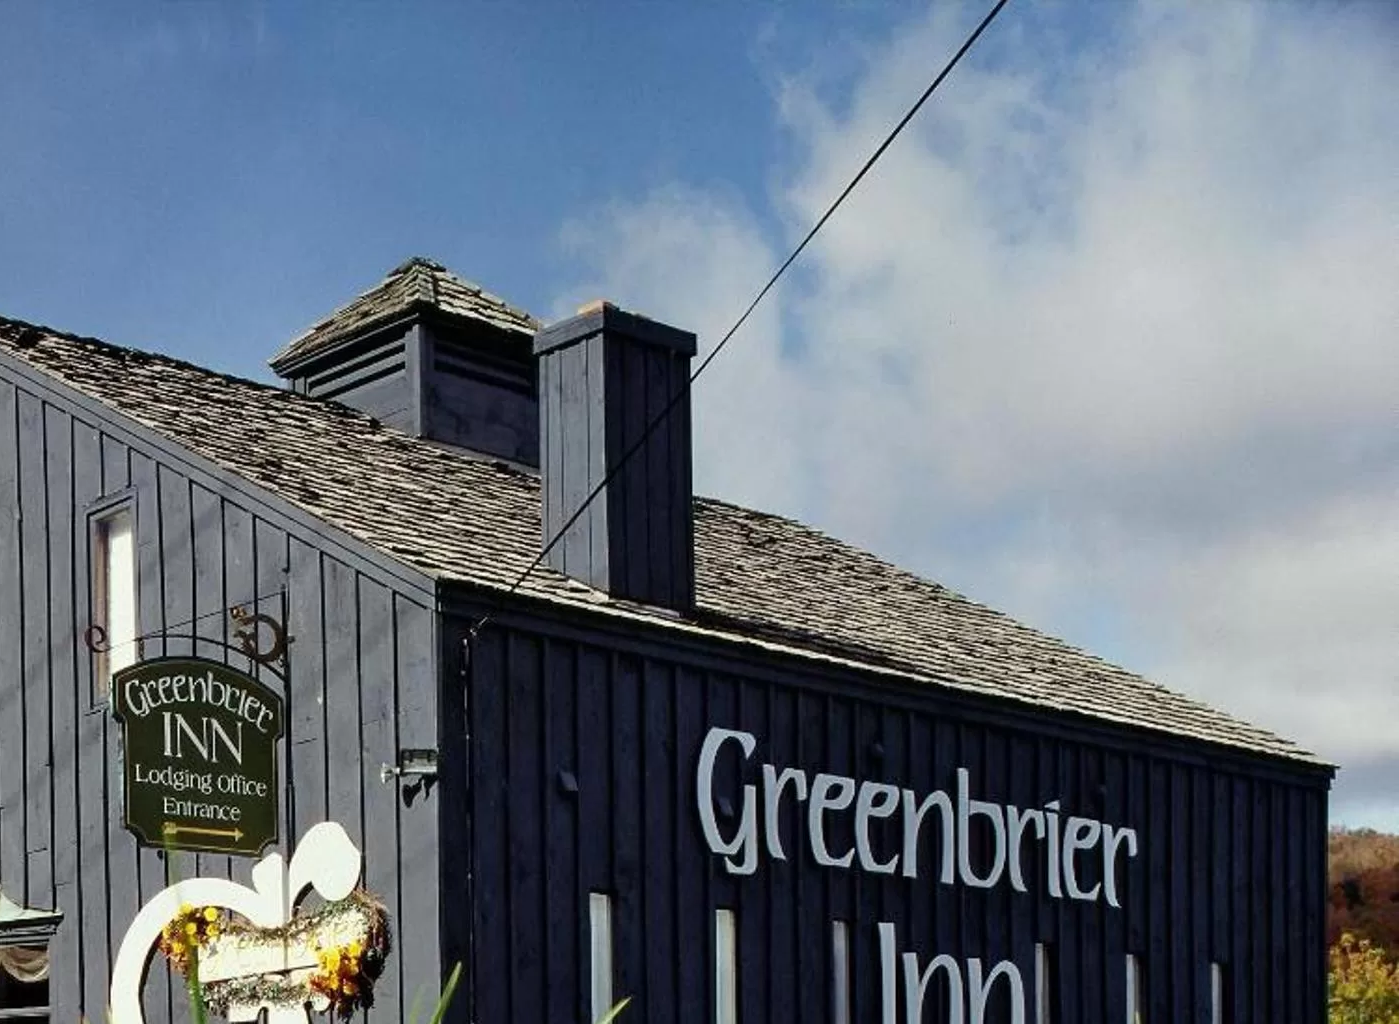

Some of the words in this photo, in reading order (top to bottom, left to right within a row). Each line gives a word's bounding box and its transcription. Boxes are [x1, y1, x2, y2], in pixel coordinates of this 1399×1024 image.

[124, 671, 274, 733] Greenbrier
[161, 711, 243, 766] INN
[135, 763, 213, 795] Lodging
[163, 797, 241, 821] Entrance
[697, 727, 1138, 908] Greenbrier
